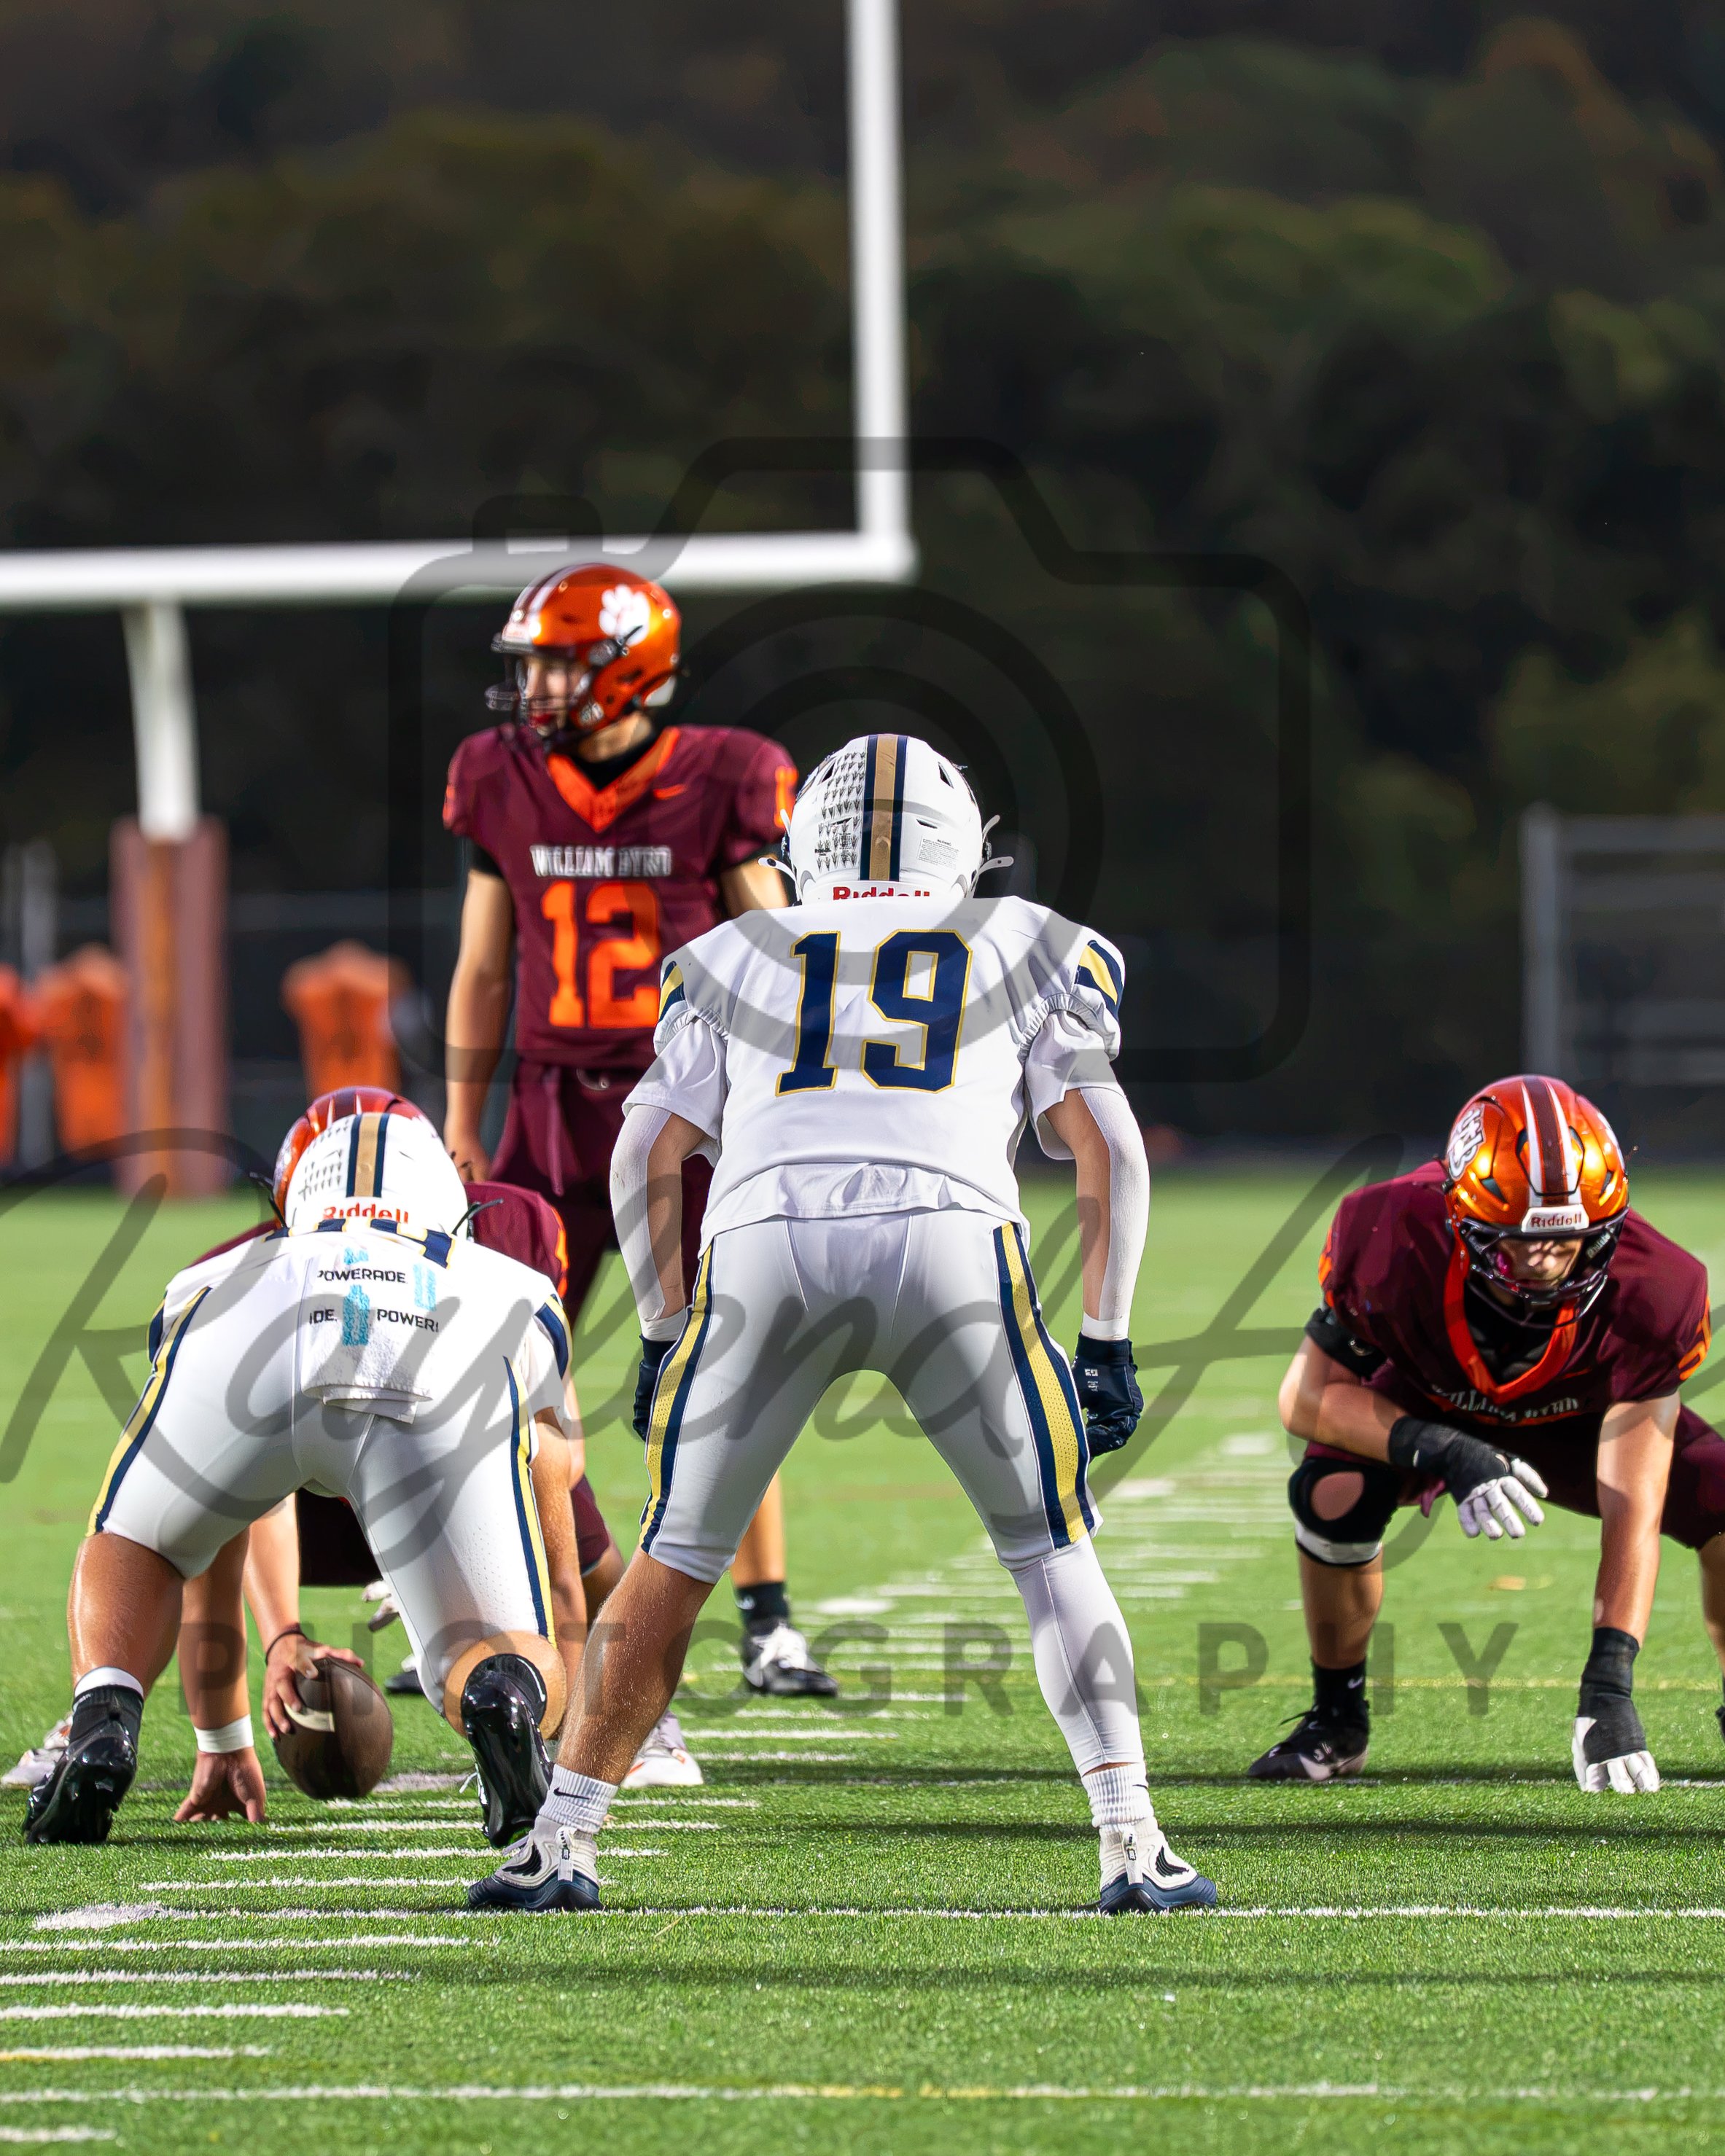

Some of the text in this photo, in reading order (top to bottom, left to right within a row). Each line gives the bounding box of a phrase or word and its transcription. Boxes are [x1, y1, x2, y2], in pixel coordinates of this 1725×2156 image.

[529, 844, 616, 878] WILLIAM
[541, 880, 661, 1029] 12
[775, 928, 973, 1098] 19
[1530, 1213, 1582, 1228] Riddell
[376, 1308, 439, 1333] POWER
